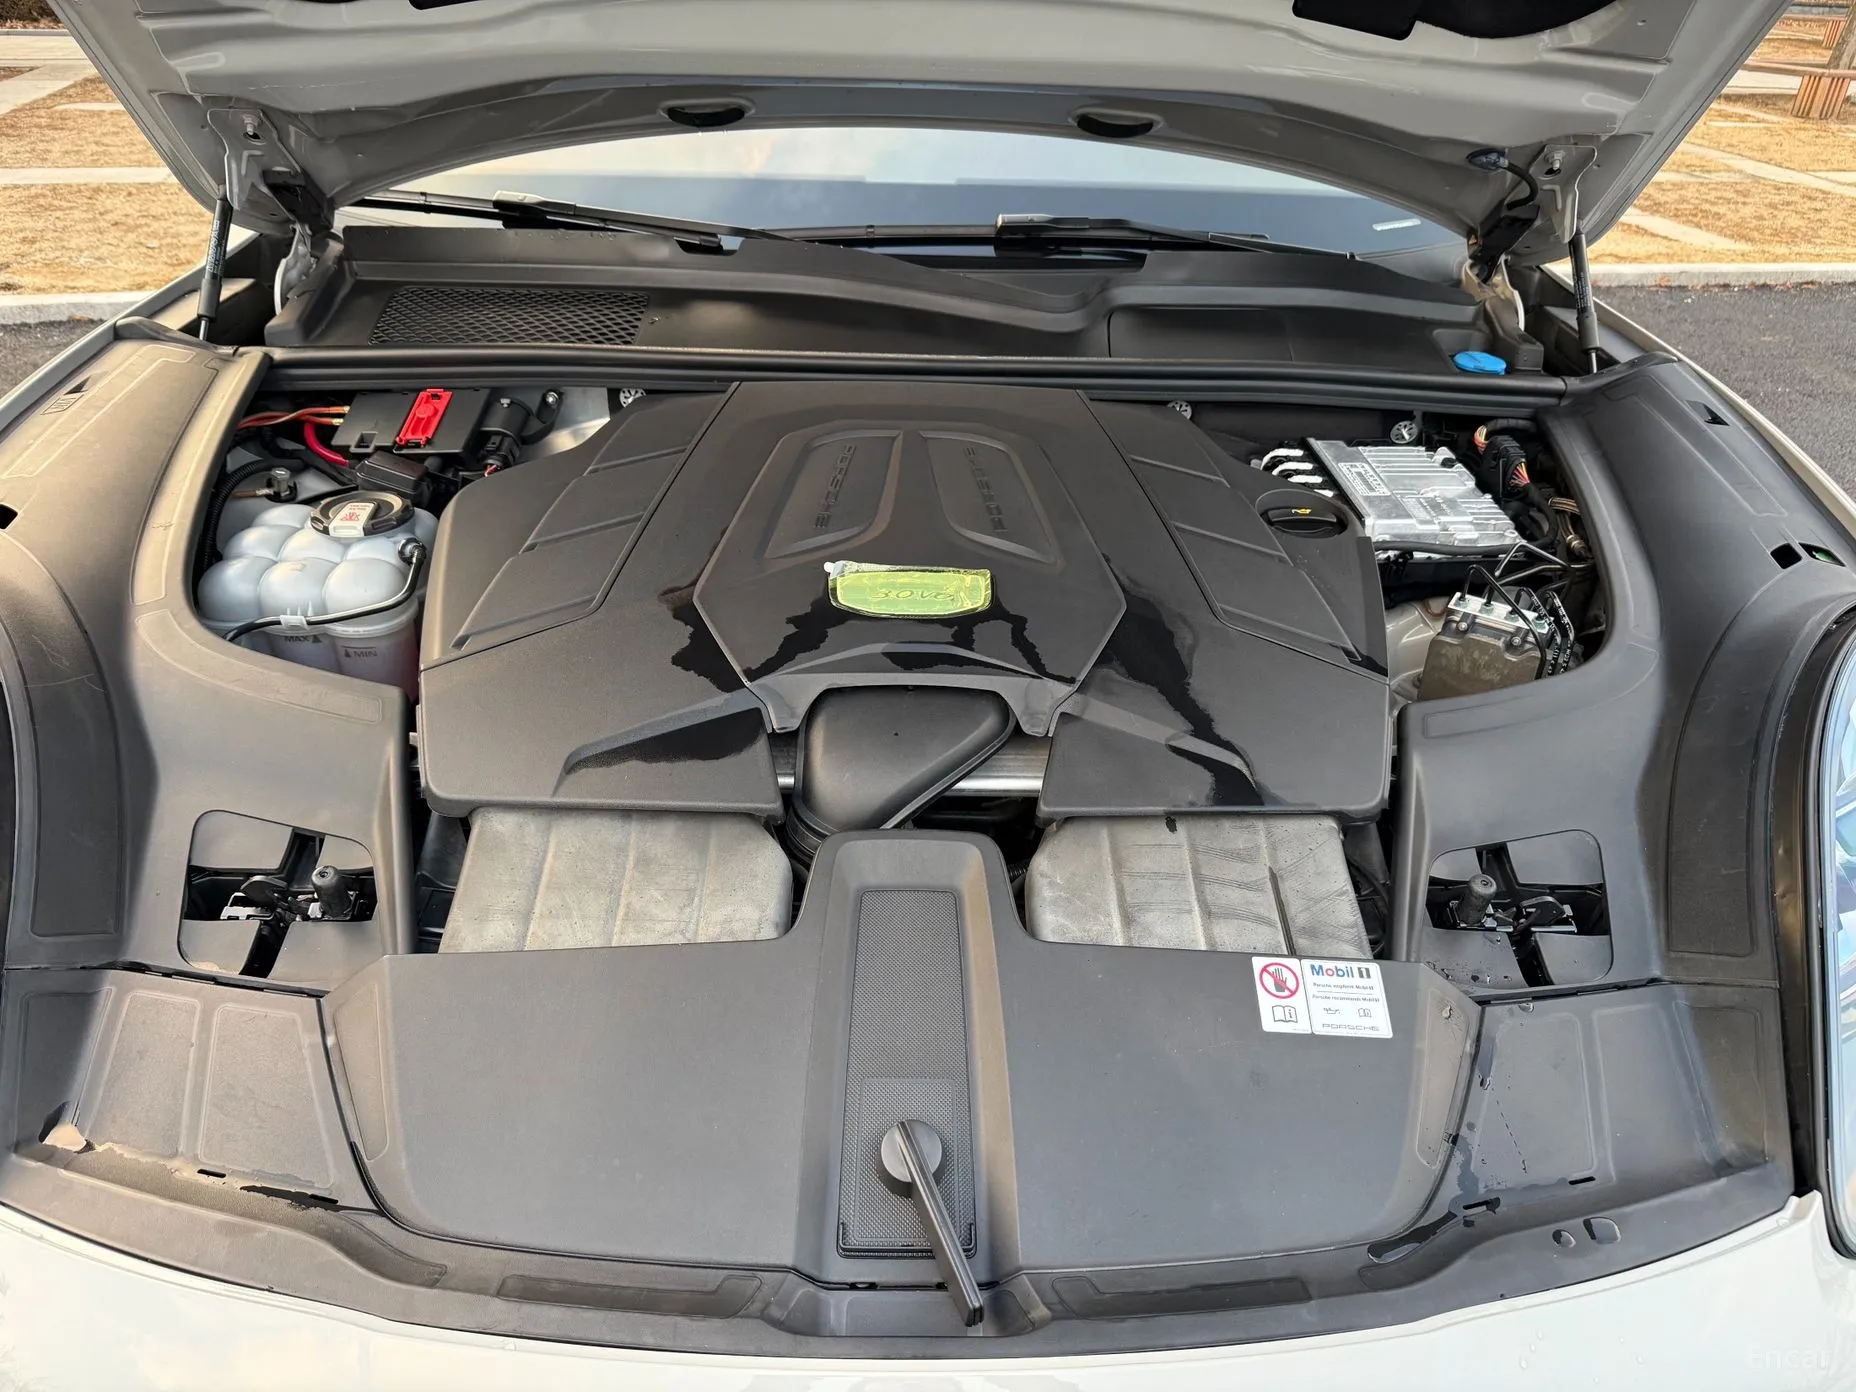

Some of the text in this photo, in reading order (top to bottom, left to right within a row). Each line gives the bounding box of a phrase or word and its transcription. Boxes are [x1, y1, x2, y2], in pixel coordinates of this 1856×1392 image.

[283, 635, 310, 643] MAX
[353, 650, 378, 658] MIN
[1310, 964, 1354, 979] Mobil
[1322, 1023, 1380, 1031] PORSCHE
